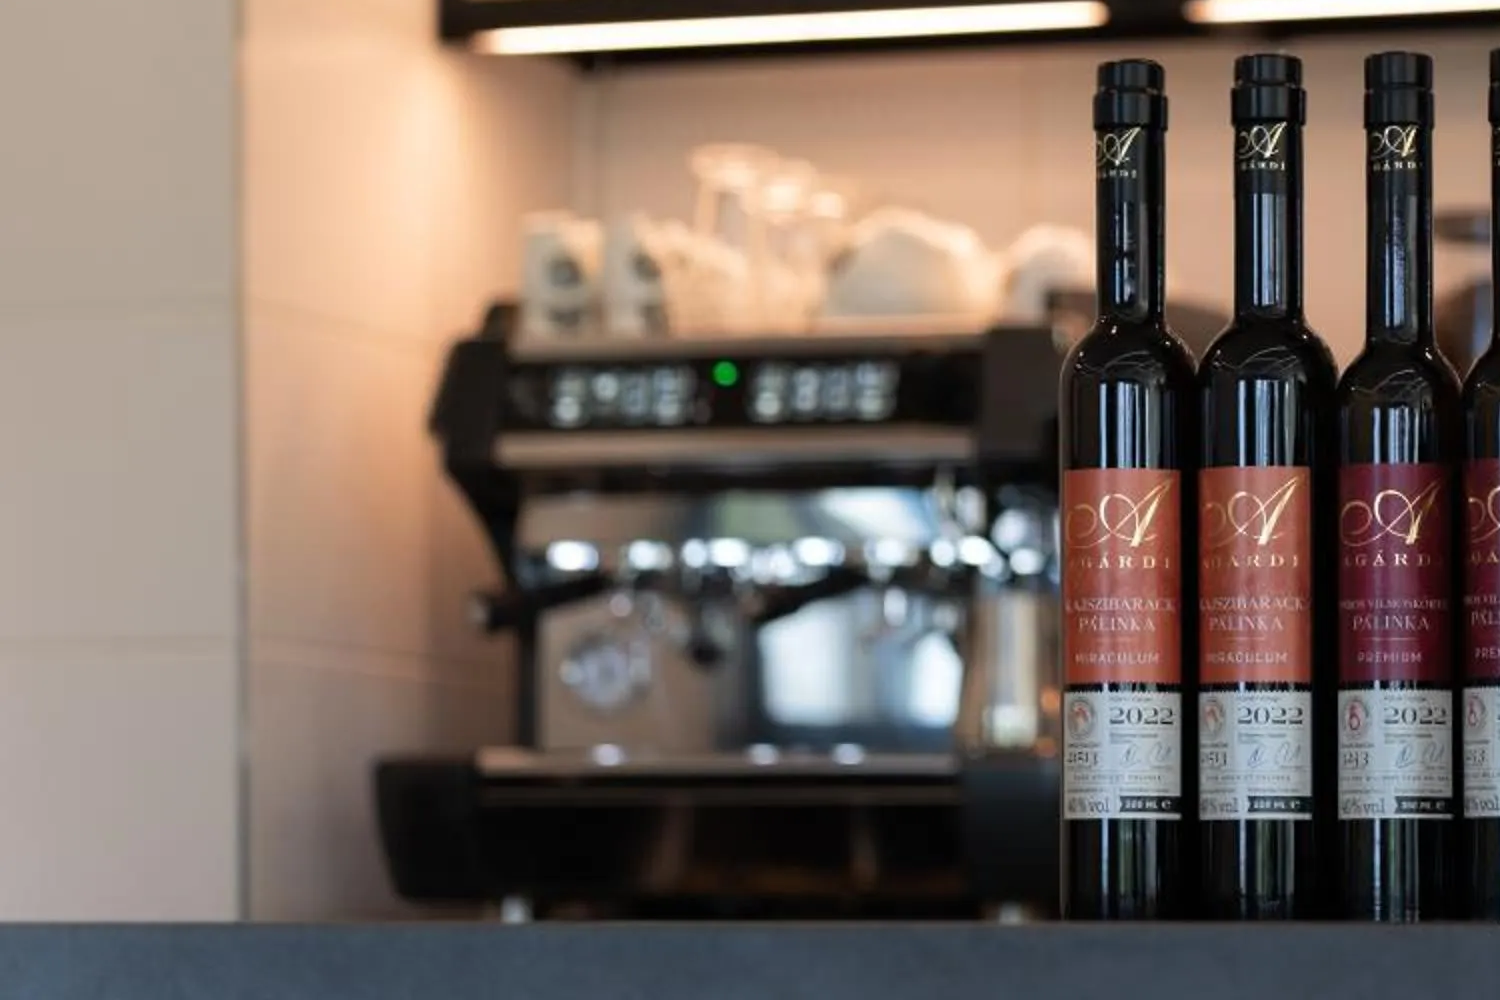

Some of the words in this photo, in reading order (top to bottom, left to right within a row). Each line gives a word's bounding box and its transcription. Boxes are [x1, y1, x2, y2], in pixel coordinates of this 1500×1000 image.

[1110, 706, 1174, 725] 2022
[1238, 706, 1303, 725] 2022
[1383, 706, 1447, 725] 2022
